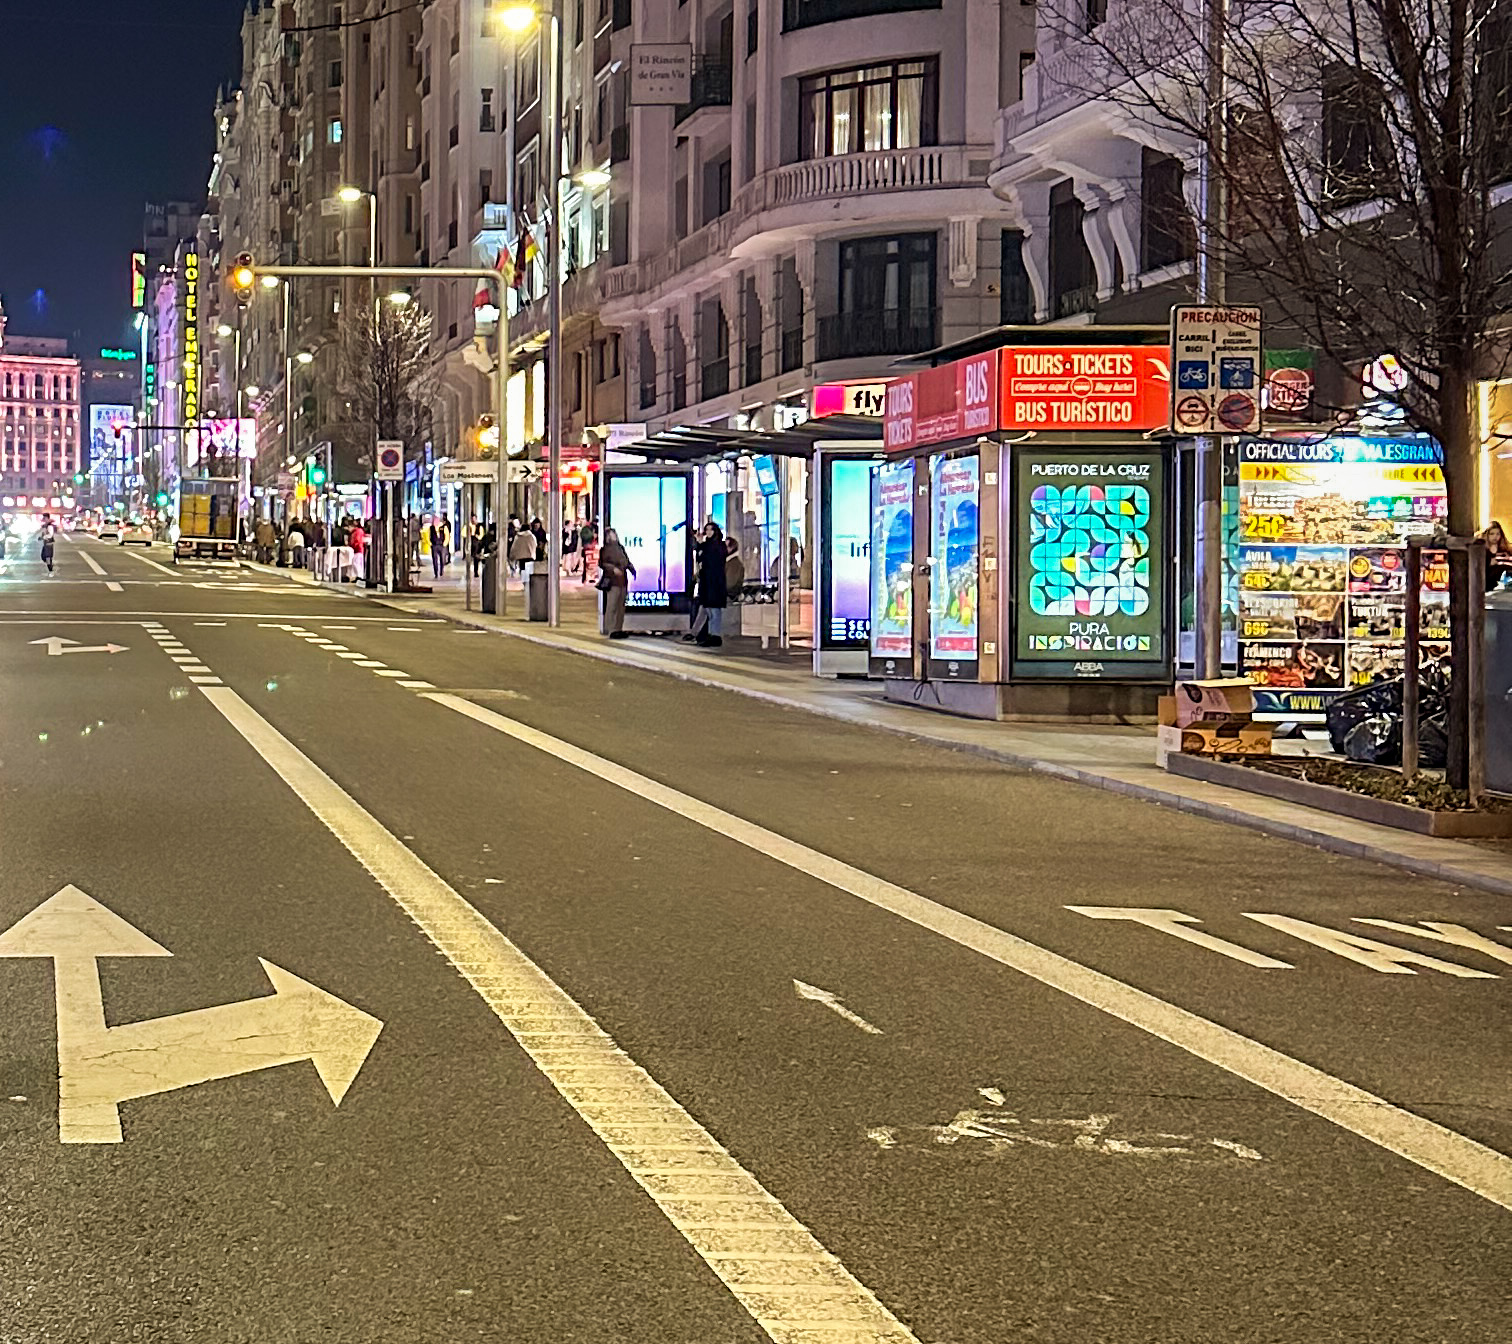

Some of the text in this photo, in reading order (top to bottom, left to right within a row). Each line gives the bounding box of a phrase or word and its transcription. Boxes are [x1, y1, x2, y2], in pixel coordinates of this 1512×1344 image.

[186, 254, 198, 321] HOTEL
[1179, 334, 1210, 342] CARRIL
[1014, 354, 1133, 375] TOURS TICKETS
[185, 334, 198, 428] EMPERADO
[965, 360, 988, 406] BUS
[1014, 398, 1133, 423] BUS TURÍSTICO
[1246, 443, 1296, 460] OFFICIAL
[1031, 464, 1150, 476] PUERTO DE LA CRUZ
[850, 542, 872, 557] lif
[1069, 622, 1110, 635] PURA
[1029, 635, 1151, 651] INSPIRACIÓN
